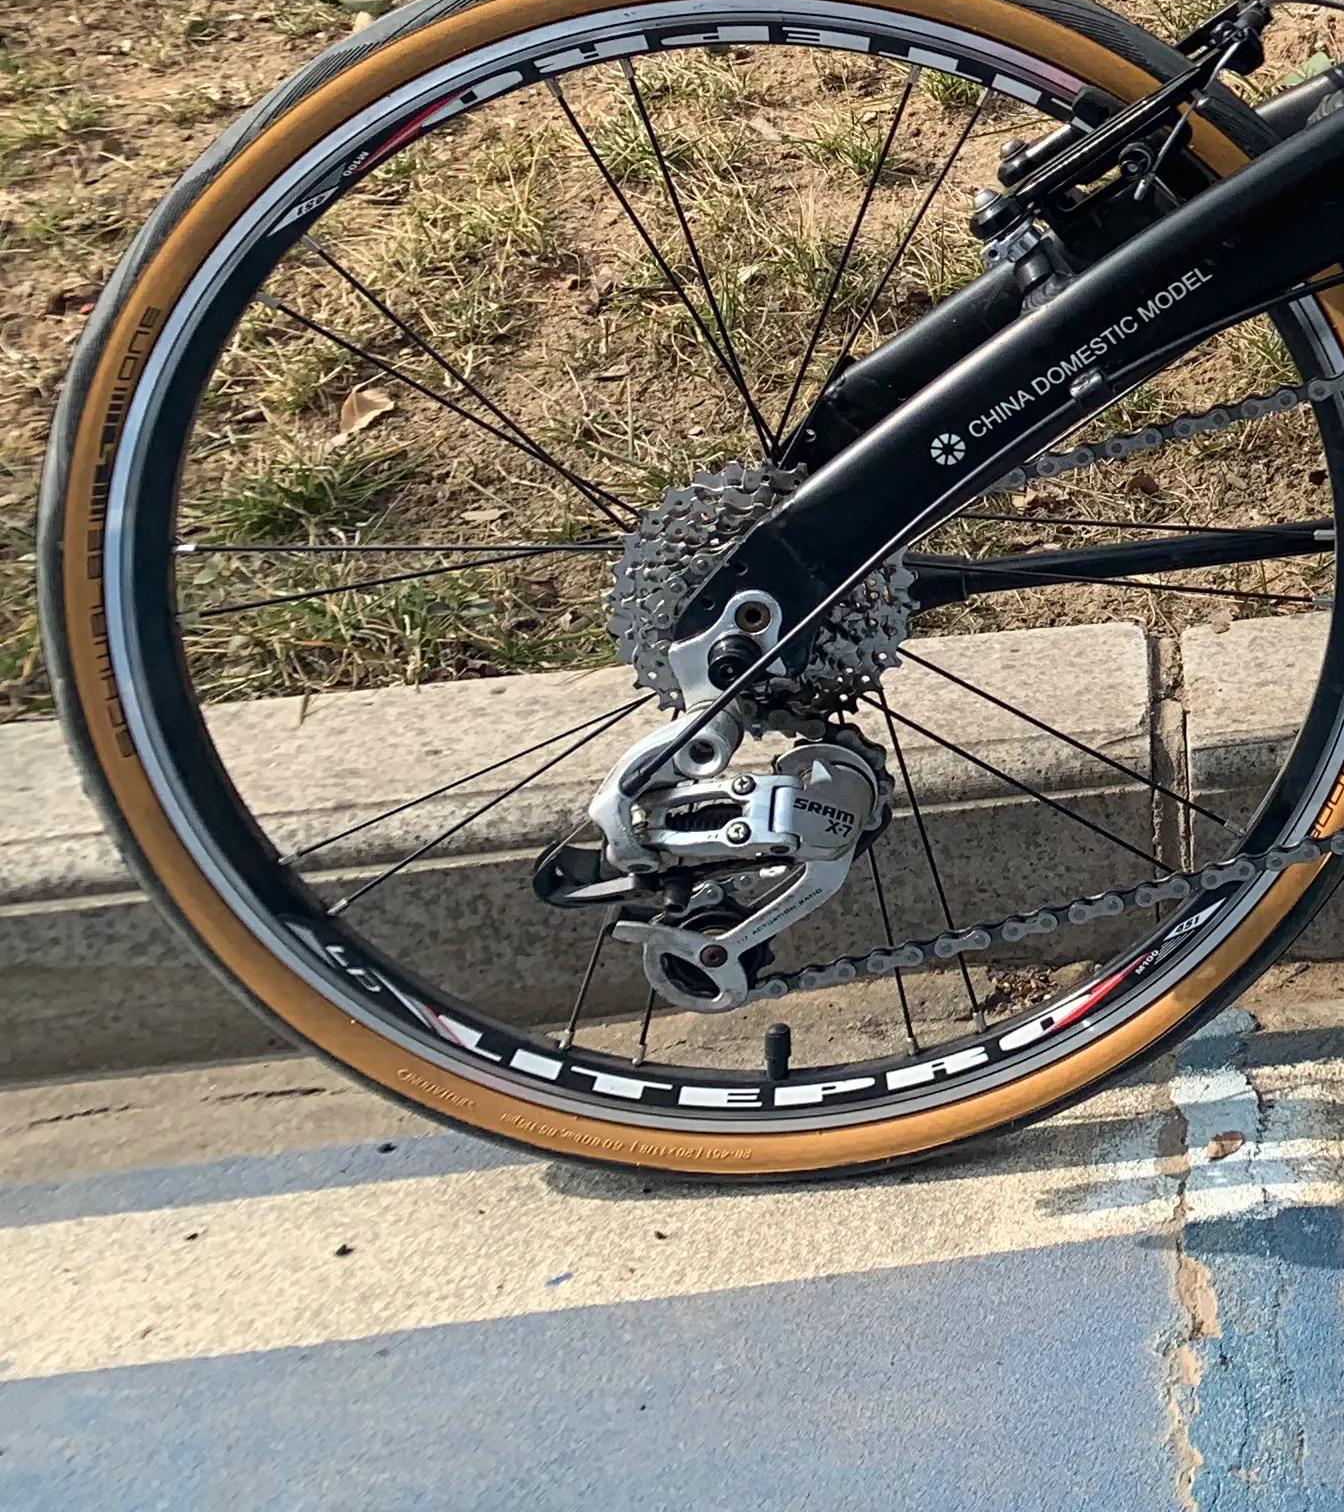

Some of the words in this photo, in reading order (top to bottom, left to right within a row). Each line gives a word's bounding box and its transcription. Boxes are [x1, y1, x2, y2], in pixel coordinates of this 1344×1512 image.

[967, 389, 1035, 438] CHINA
[1031, 315, 1139, 396] DOMESTIC
[1132, 267, 1213, 322] MODEL
[792, 797, 855, 825] SRAM
[1174, 916, 1200, 935] 451
[439, 978, 1112, 1106] LITEPRO
